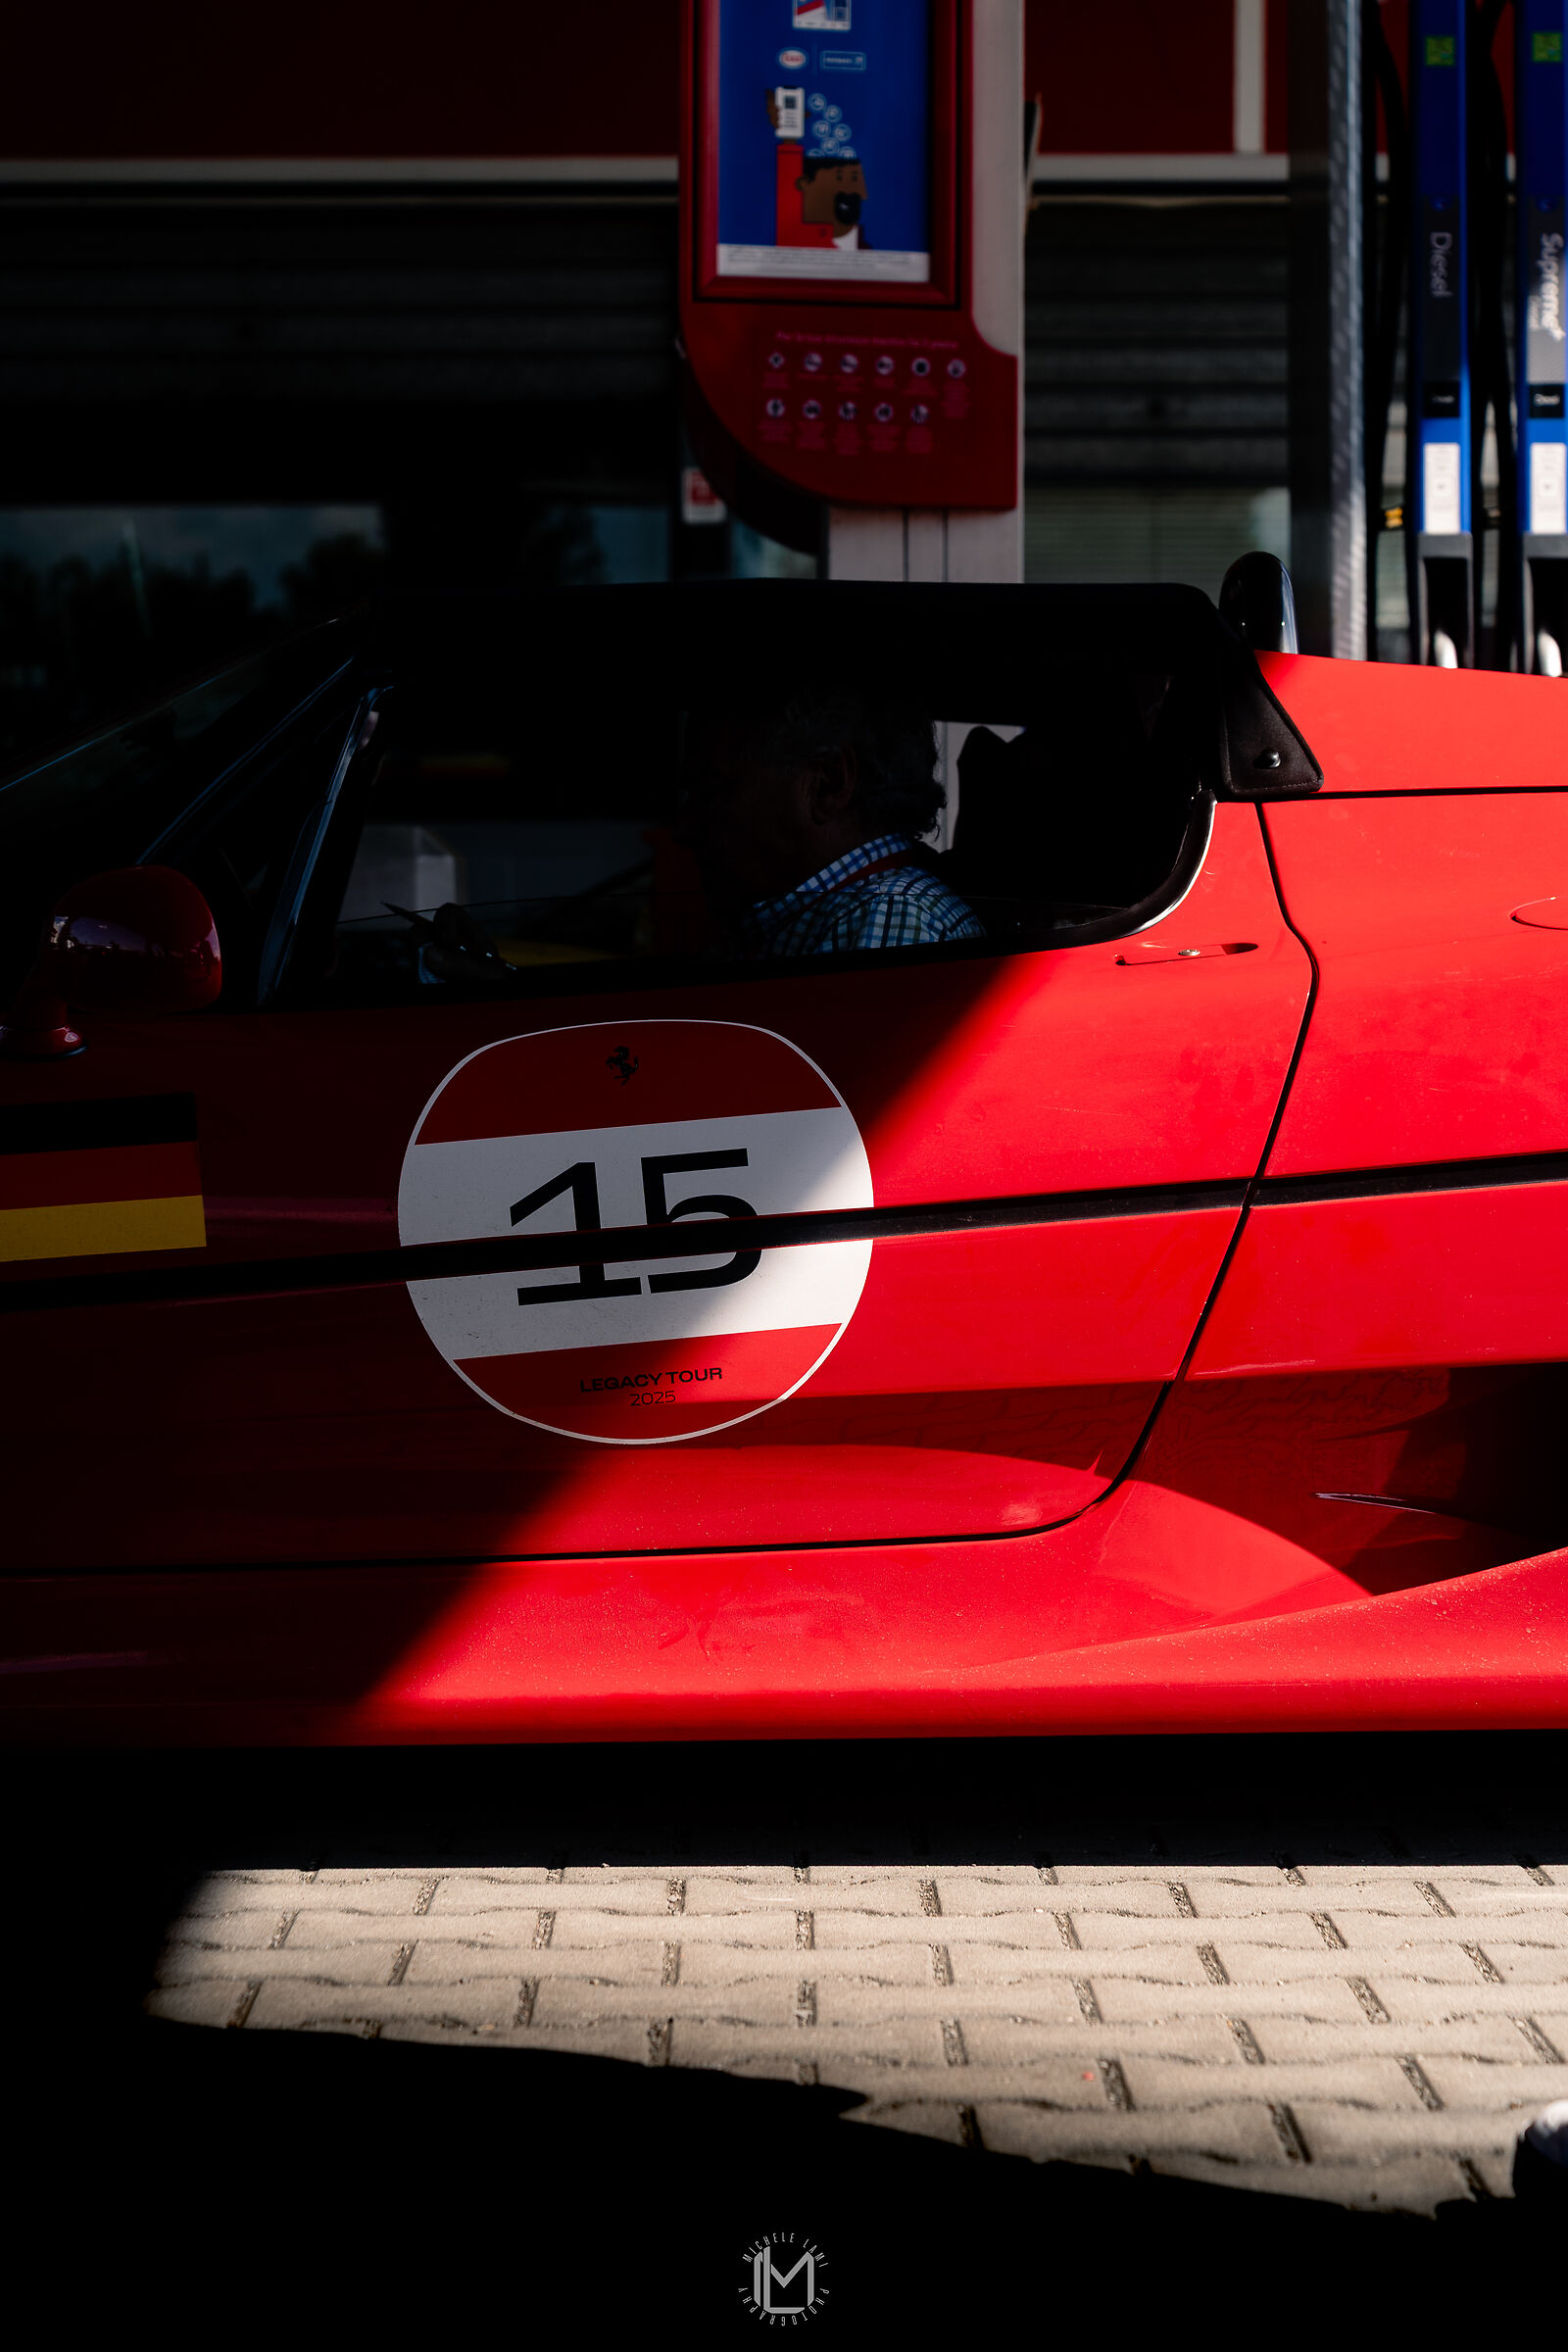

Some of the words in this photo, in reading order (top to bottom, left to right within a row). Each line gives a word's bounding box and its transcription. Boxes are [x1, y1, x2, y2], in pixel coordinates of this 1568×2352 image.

[1430, 231, 1453, 297] Diesel
[511, 1149, 761, 1304] 15
[580, 1372, 663, 1393] LEGACY
[665, 1367, 723, 1384] TOUR
[630, 1391, 676, 1406] 2025
